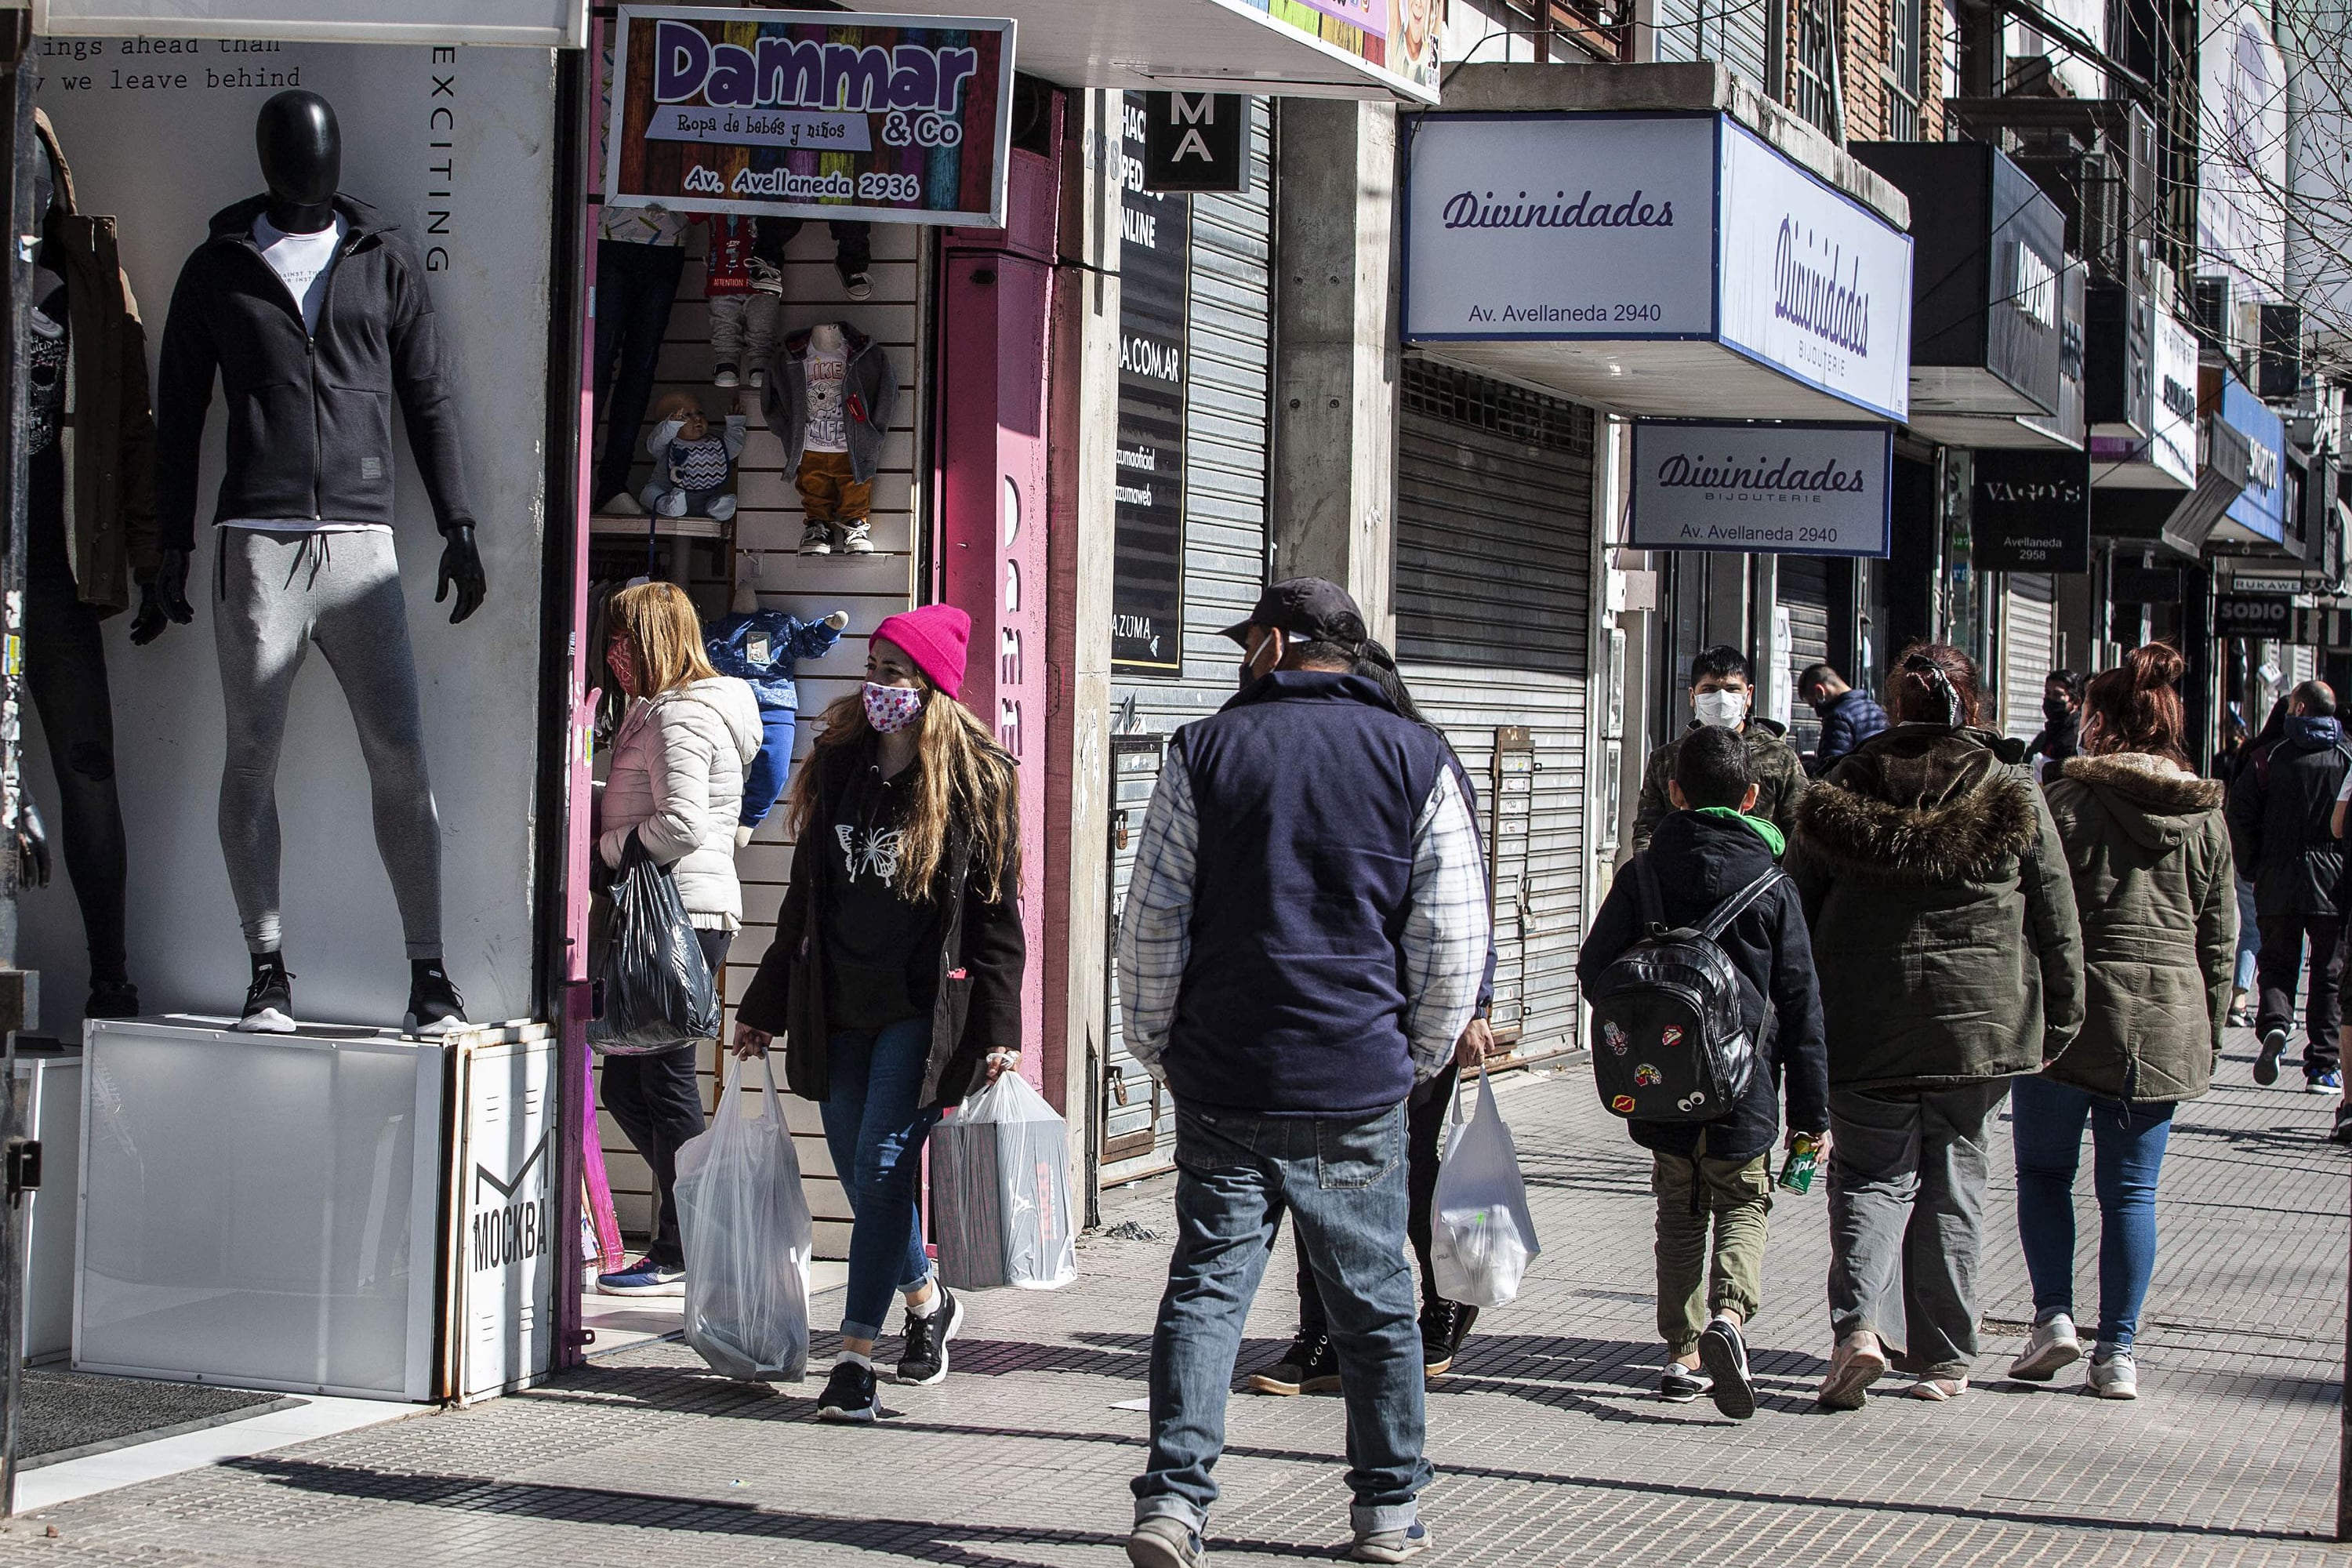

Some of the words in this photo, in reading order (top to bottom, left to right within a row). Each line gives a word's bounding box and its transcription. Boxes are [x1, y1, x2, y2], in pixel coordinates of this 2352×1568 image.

[38, 37, 102, 60] ings
[122, 38, 198, 54] ahead
[655, 20, 977, 113] Dammar
[61, 75, 92, 90] we
[111, 69, 187, 89] leave
[206, 67, 300, 89] behind
[677, 114, 717, 133] Ropa
[723, 114, 739, 132] de
[745, 117, 785, 136] bebés
[790, 124, 800, 146] y
[806, 121, 845, 140] niños
[884, 113, 910, 145] &
[915, 113, 963, 147] Co
[426, 45, 456, 272] EXCITING
[684, 165, 724, 193] Av.
[732, 167, 852, 199] Avellaneda
[858, 172, 919, 201] 2936
[1443, 190, 1674, 229] Divinidades
[713, 278, 743, 287] ATTENTION
[1774, 212, 1869, 359] Divinidades
[1468, 305, 1497, 322] Av.
[1503, 304, 1606, 322] Avellaneda
[1613, 304, 1661, 322] 2940
[1798, 340, 1846, 377] BIJOUTERIE
[807, 361, 843, 381] LIKE
[809, 419, 845, 441] LIFE
[1658, 453, 1864, 492] Divinidades
[1705, 492, 1821, 503] BIJOUTERIE
[1680, 524, 1703, 539] Av.
[1708, 524, 1793, 542] Avellaneda
[1798, 527, 1838, 543] 2940
[2004, 536, 2062, 548] Avellaneda
[2020, 550, 2046, 560] 2958
[2235, 580, 2299, 590] RUKAWE
[2221, 602, 2286, 619] SODIO
